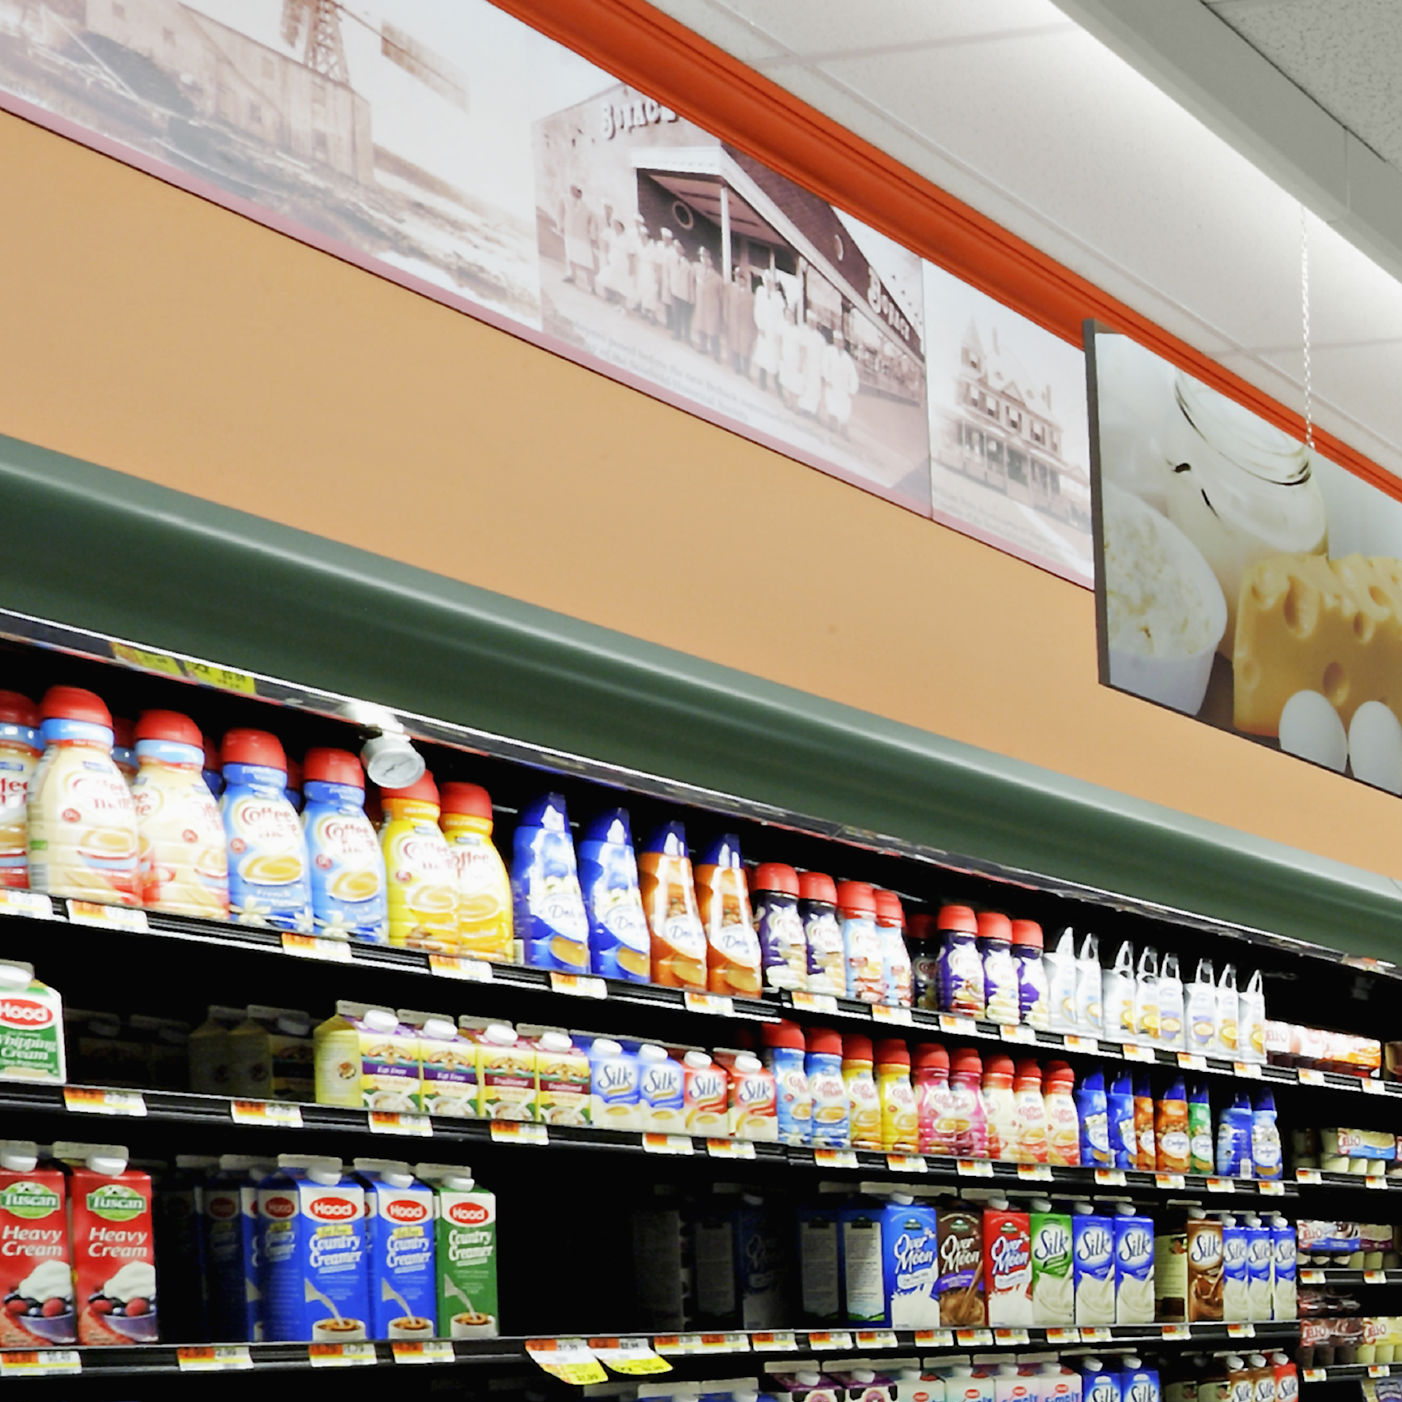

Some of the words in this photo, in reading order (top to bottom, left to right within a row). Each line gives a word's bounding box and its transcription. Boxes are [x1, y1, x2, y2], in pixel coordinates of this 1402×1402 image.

[598, 1065, 632, 1089] Silk
[643, 1067, 677, 1093] Silk
[689, 1075, 721, 1098] Silk
[740, 1079, 770, 1101] Silk
[5, 1195, 57, 1207] Tuscan
[93, 1196, 143, 1210] Tuscan
[313, 1202, 352, 1216] Hood
[389, 1203, 424, 1217] Hood
[452, 1208, 485, 1221] Hood
[2, 1226, 63, 1243] Heavy
[88, 1227, 147, 1246] Heavy
[309, 1234, 361, 1252] Country
[387, 1235, 430, 1252] Country
[448, 1229, 492, 1246] Country
[2, 1242, 63, 1256] Cream
[88, 1243, 147, 1257] Cream
[448, 1245, 493, 1262] Creamer
[1033, 1228, 1070, 1261] Silk
[1077, 1229, 1114, 1262] Silk
[1116, 1229, 1152, 1262] Silk
[1191, 1234, 1222, 1263] Silk
[309, 1250, 363, 1268] Creamer
[386, 1251, 432, 1268] Creamer
[899, 1251, 934, 1275] Moon
[945, 1250, 980, 1274] Moon
[994, 1251, 1029, 1274] Moon
